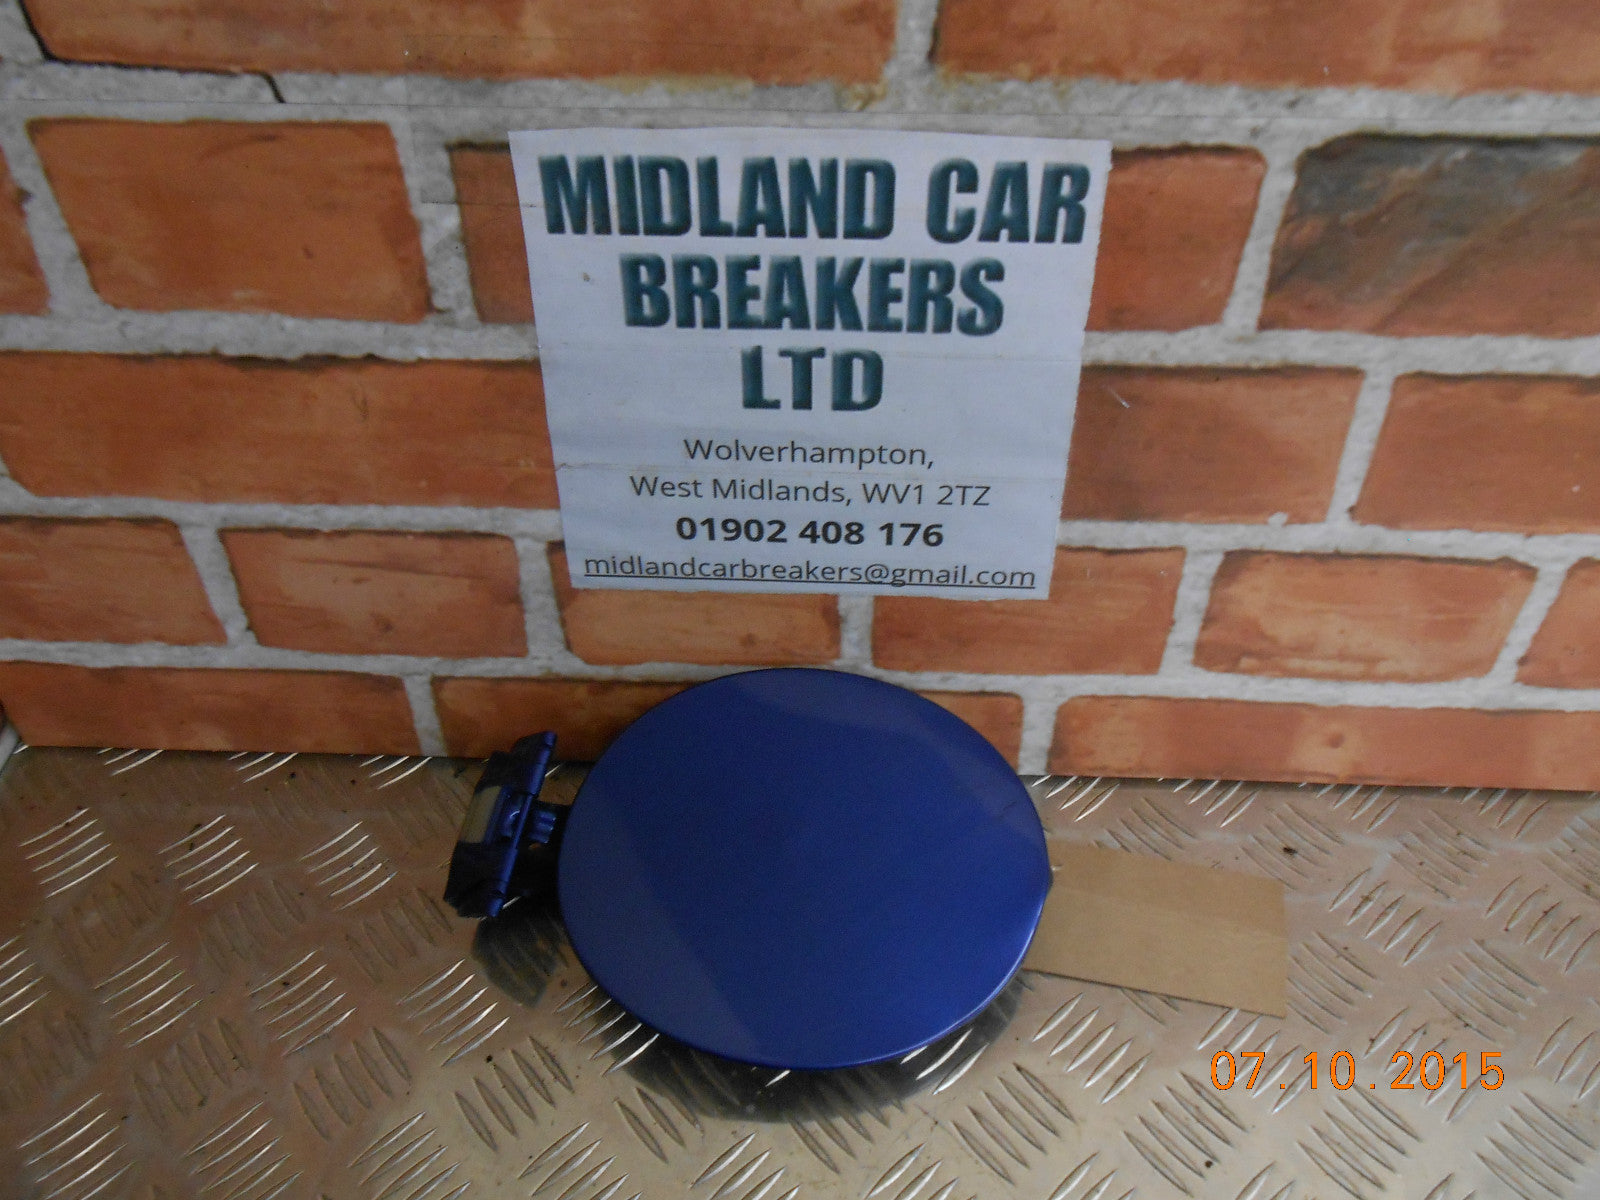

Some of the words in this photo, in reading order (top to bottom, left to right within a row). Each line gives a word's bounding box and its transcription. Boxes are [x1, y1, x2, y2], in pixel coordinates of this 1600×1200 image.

[538, 154, 896, 240] MIDLAND
[926, 157, 1091, 244] CAR
[619, 252, 1006, 336] BREAKERS
[741, 345, 884, 411] LTD
[683, 438, 934, 470] Wolverhampton,
[630, 475, 703, 499] West
[712, 477, 852, 506] Midlands,
[862, 482, 924, 505] WV1
[937, 484, 991, 507] 2TZ
[675, 516, 788, 543] 01902
[798, 520, 865, 545] 408
[878, 522, 944, 548] 176
[584, 555, 1036, 589] midlandcarbreakers@gmail.com
